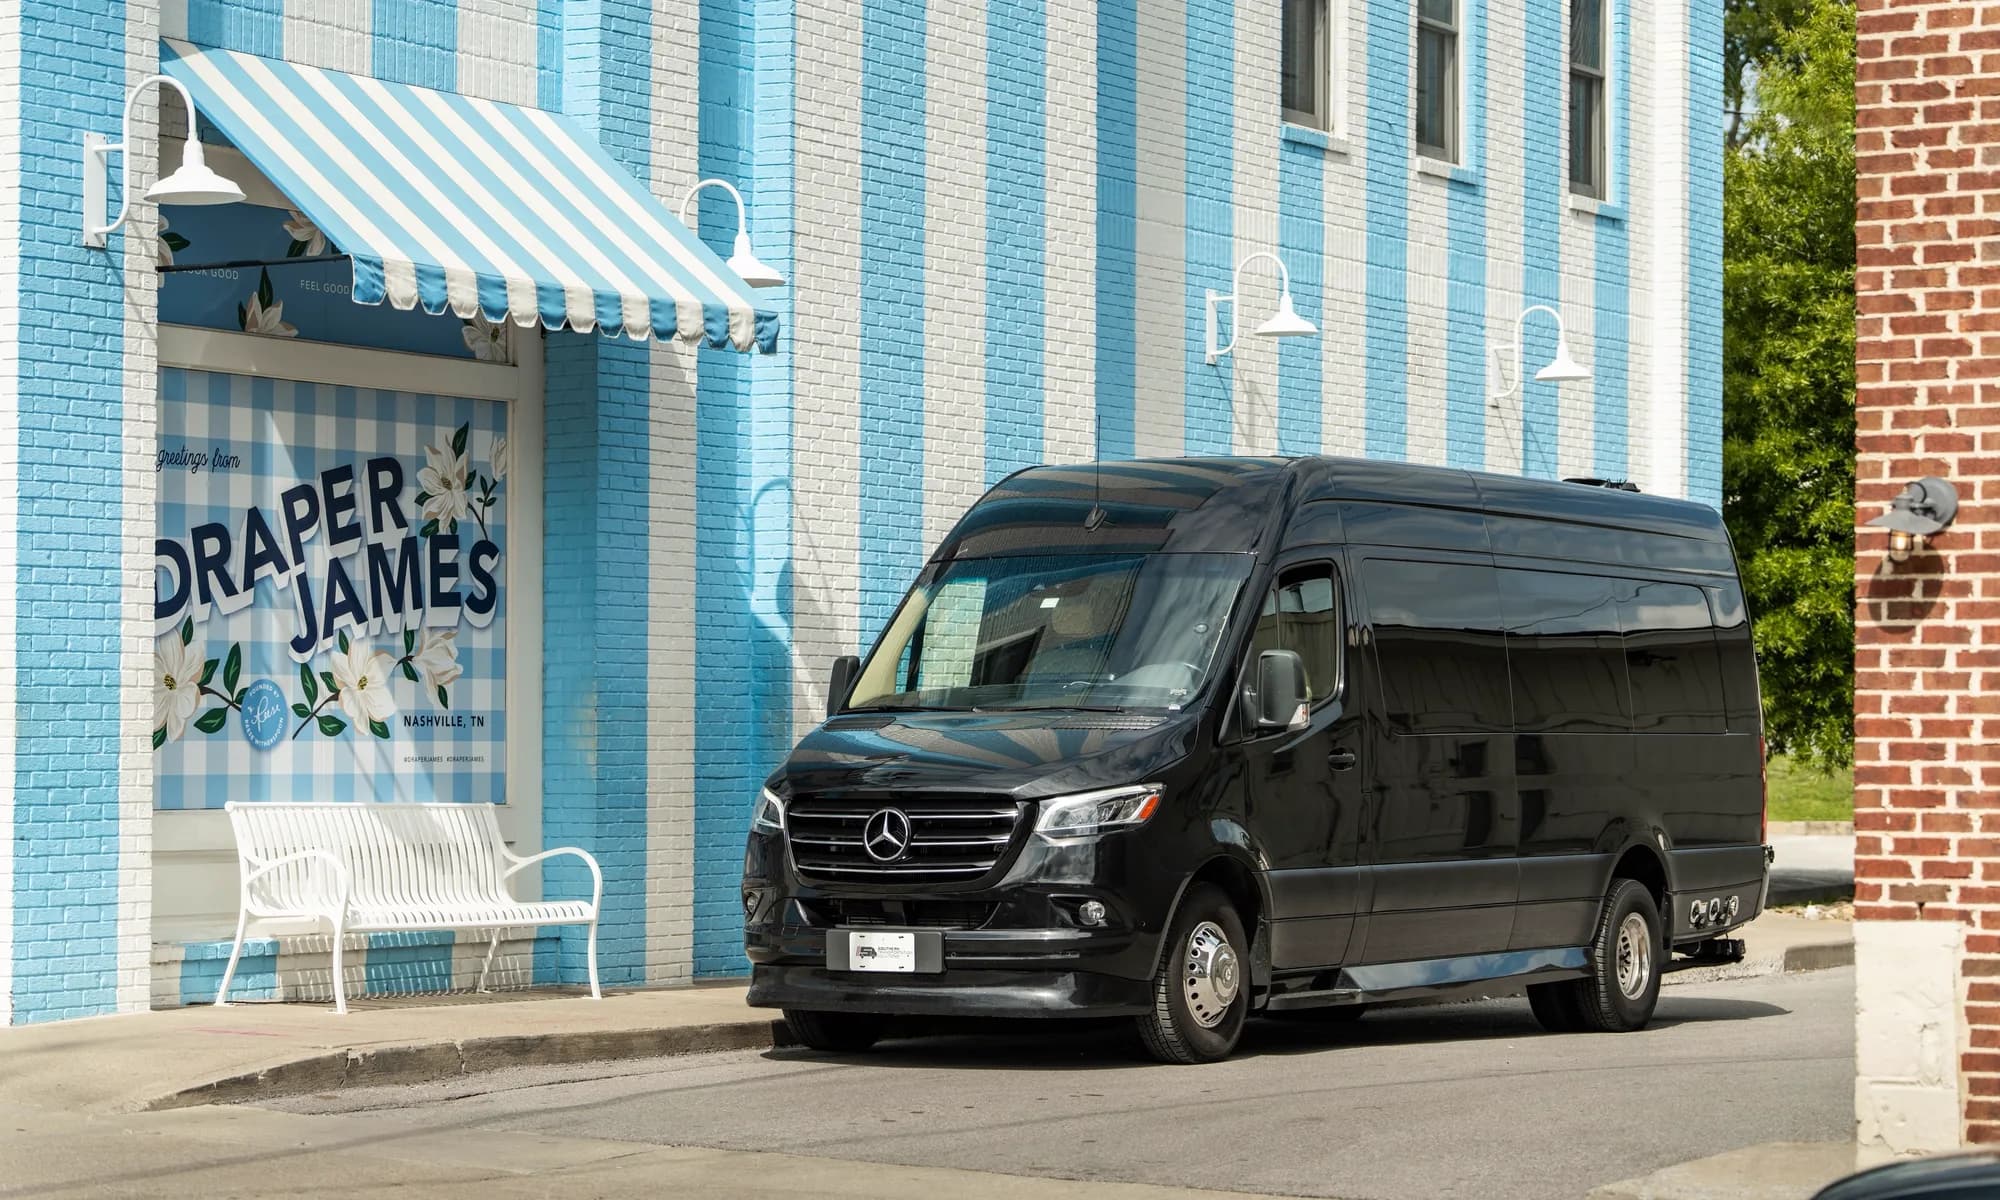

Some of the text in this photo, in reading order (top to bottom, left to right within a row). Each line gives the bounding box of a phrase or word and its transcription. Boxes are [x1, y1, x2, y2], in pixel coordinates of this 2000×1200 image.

[210, 268, 239, 280] GOOD
[300, 279, 350, 295] FEEL GOOD
[156, 444, 241, 474] greetings from
[155, 456, 408, 620] DRAPER
[289, 534, 500, 656] JAMES
[403, 715, 485, 729] NASHVILLE, TN
